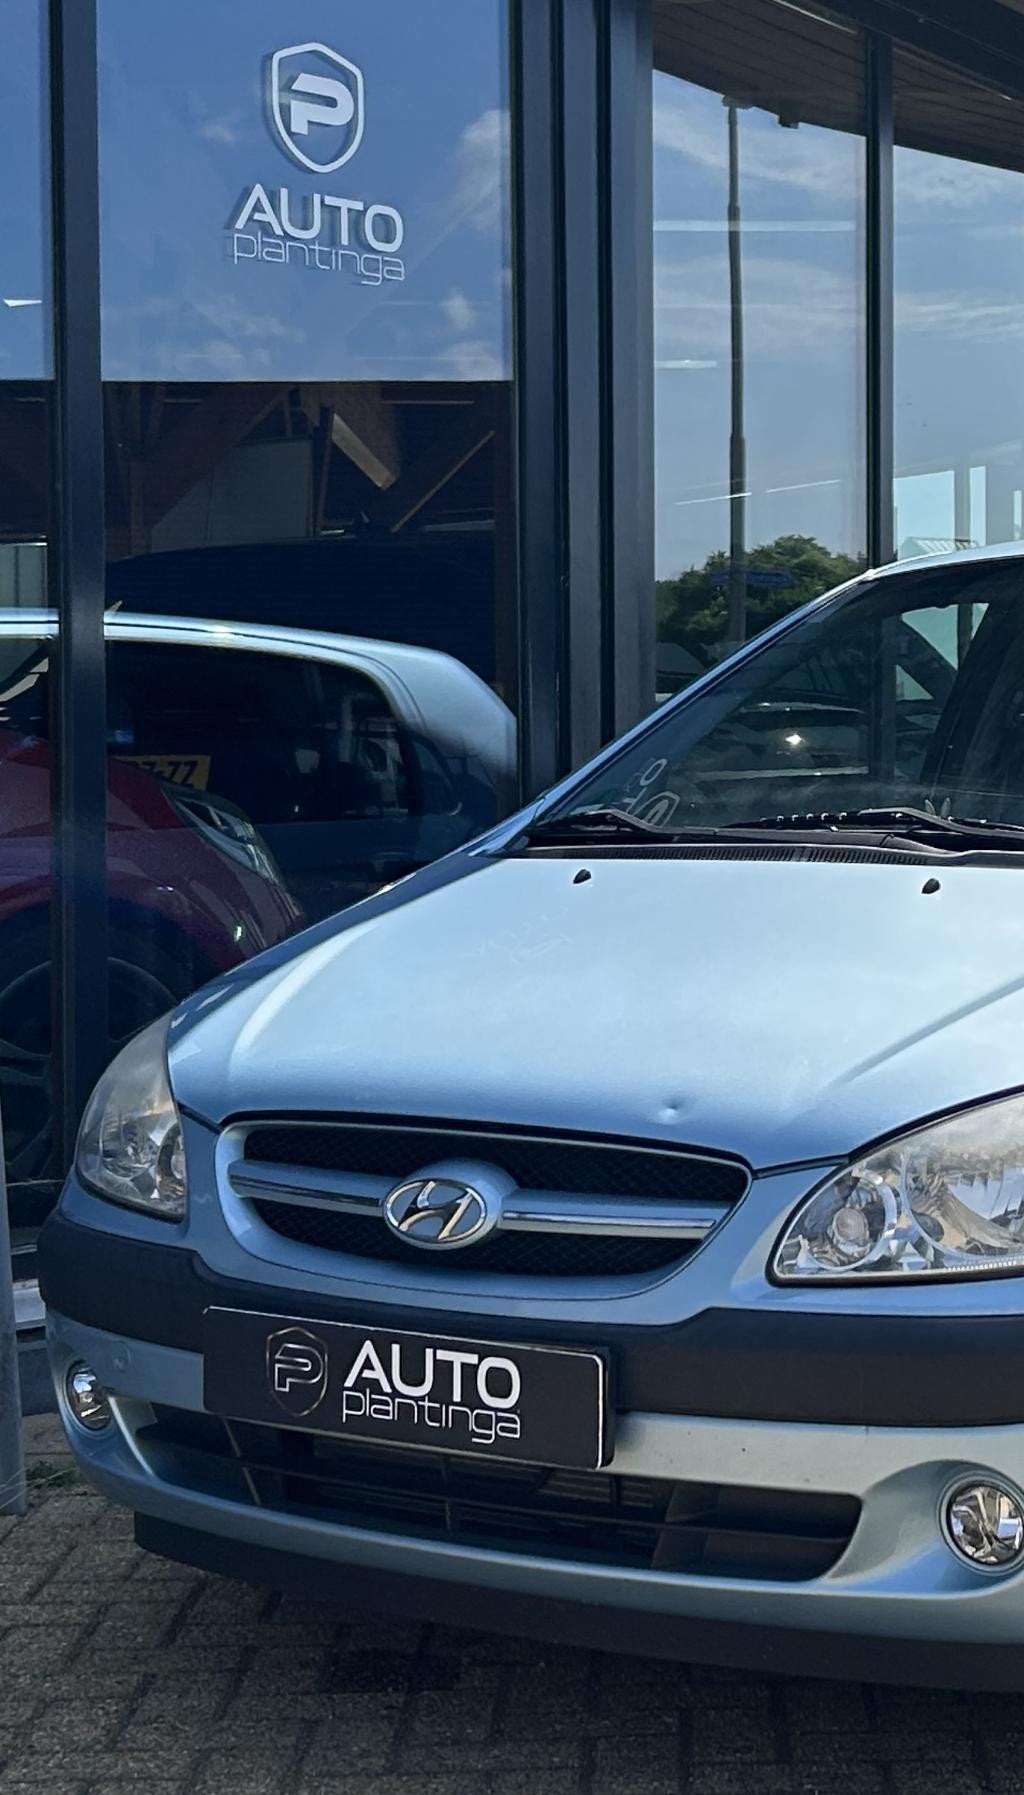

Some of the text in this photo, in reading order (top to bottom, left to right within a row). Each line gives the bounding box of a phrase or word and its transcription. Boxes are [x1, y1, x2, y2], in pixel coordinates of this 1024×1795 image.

[234, 183, 404, 253] AUTO
[233, 230, 405, 287] plantinga
[343, 1339, 521, 1409] AUTO
[342, 1388, 521, 1444] plantinga
